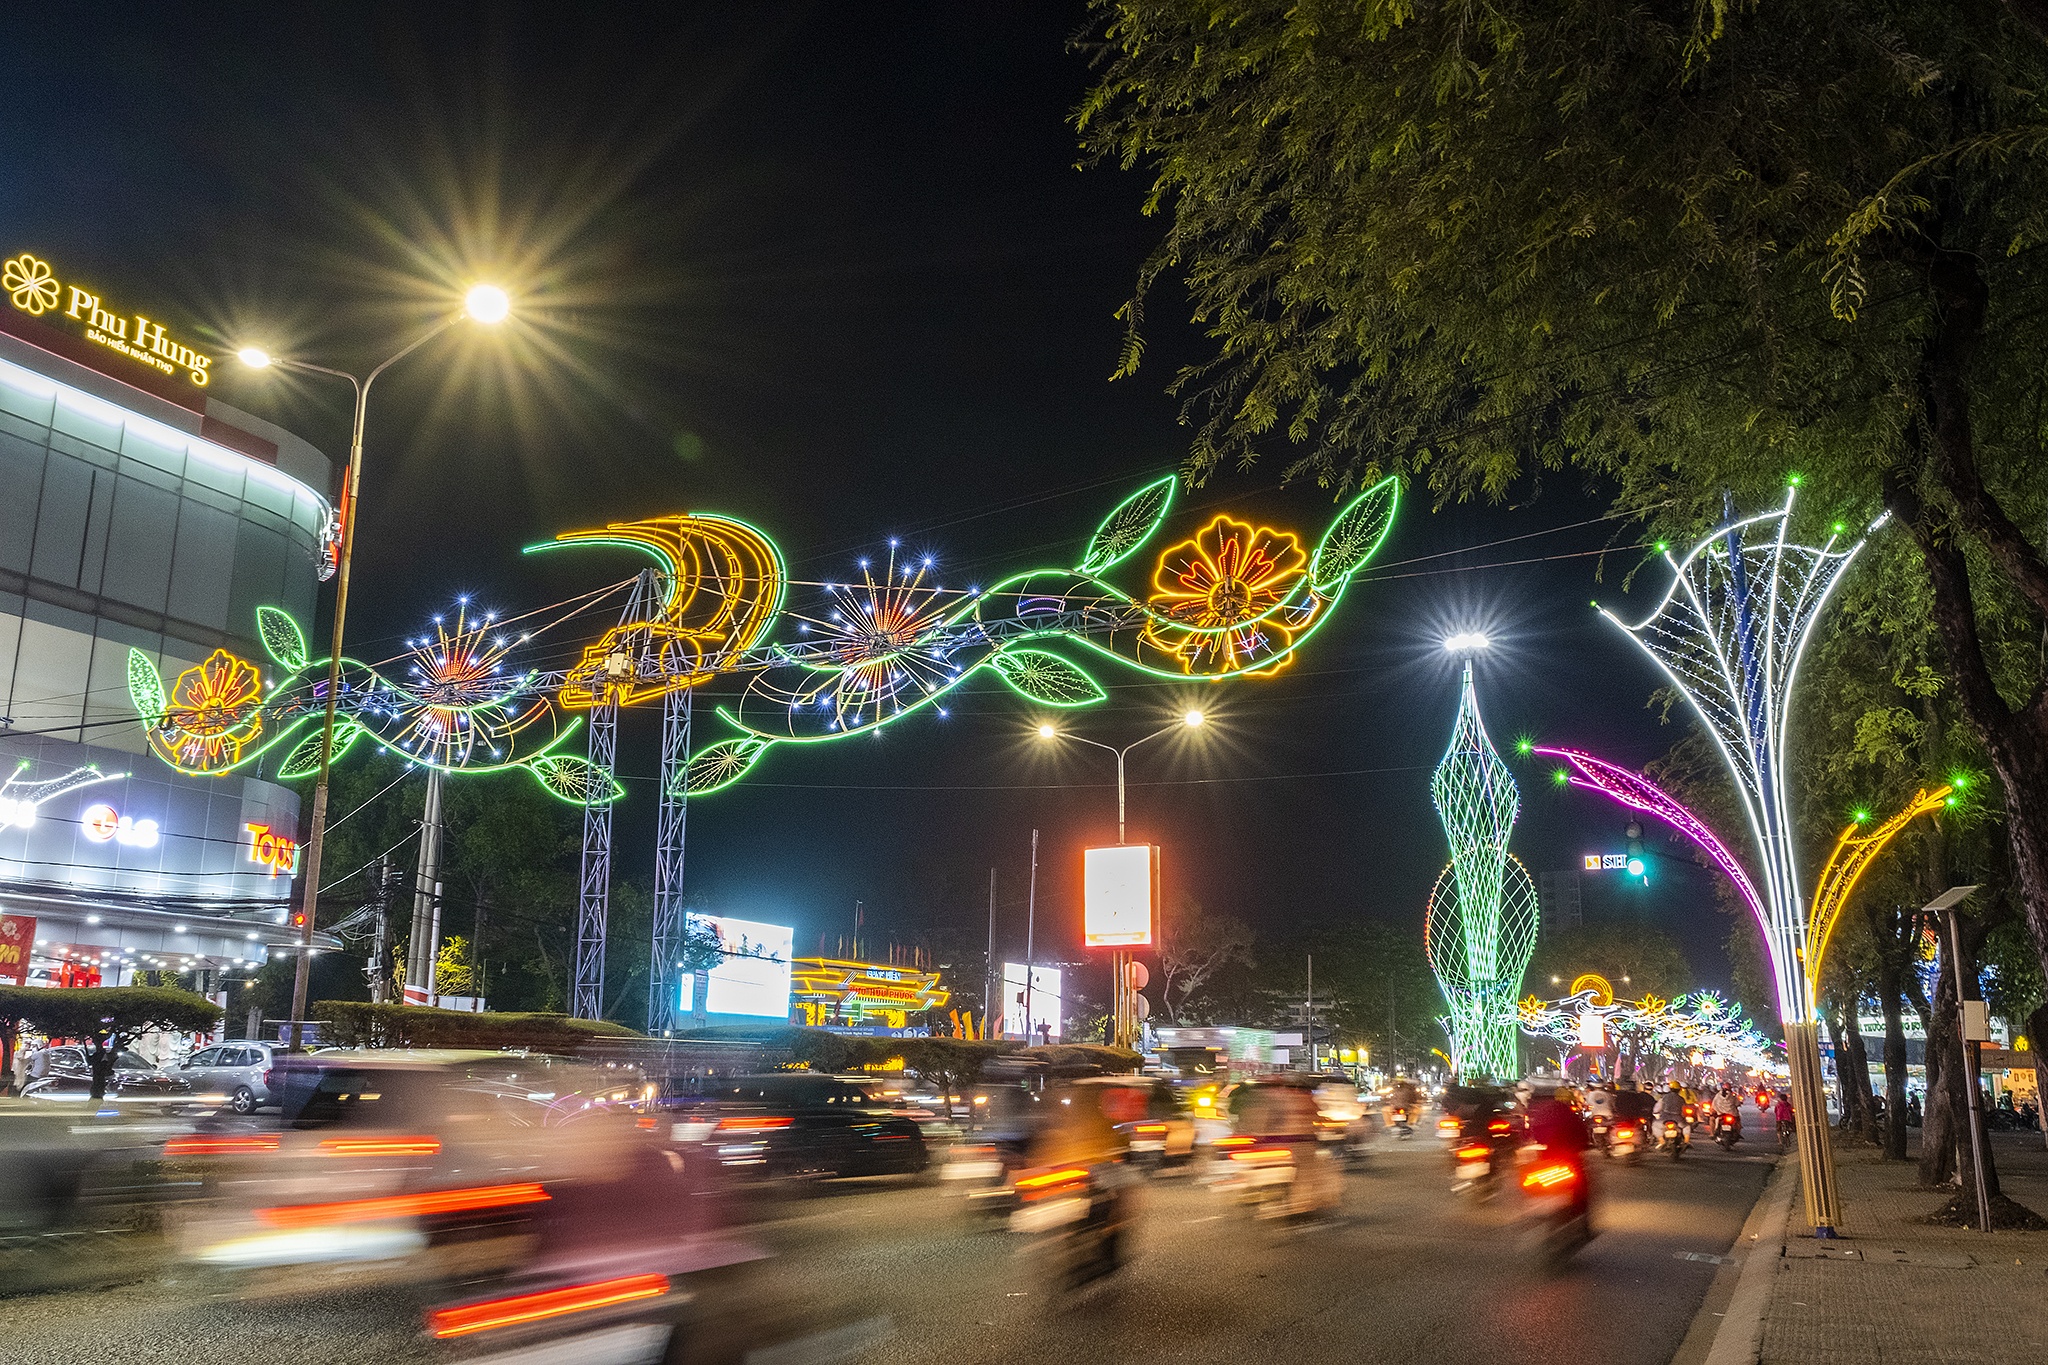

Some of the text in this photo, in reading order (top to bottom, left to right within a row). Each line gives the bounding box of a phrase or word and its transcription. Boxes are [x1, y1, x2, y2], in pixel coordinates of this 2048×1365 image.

[65, 286, 212, 386] Phu Hung
[87, 329, 107, 345] BẢO
[155, 358, 174, 375] THỌ
[245, 823, 294, 879] Tops
